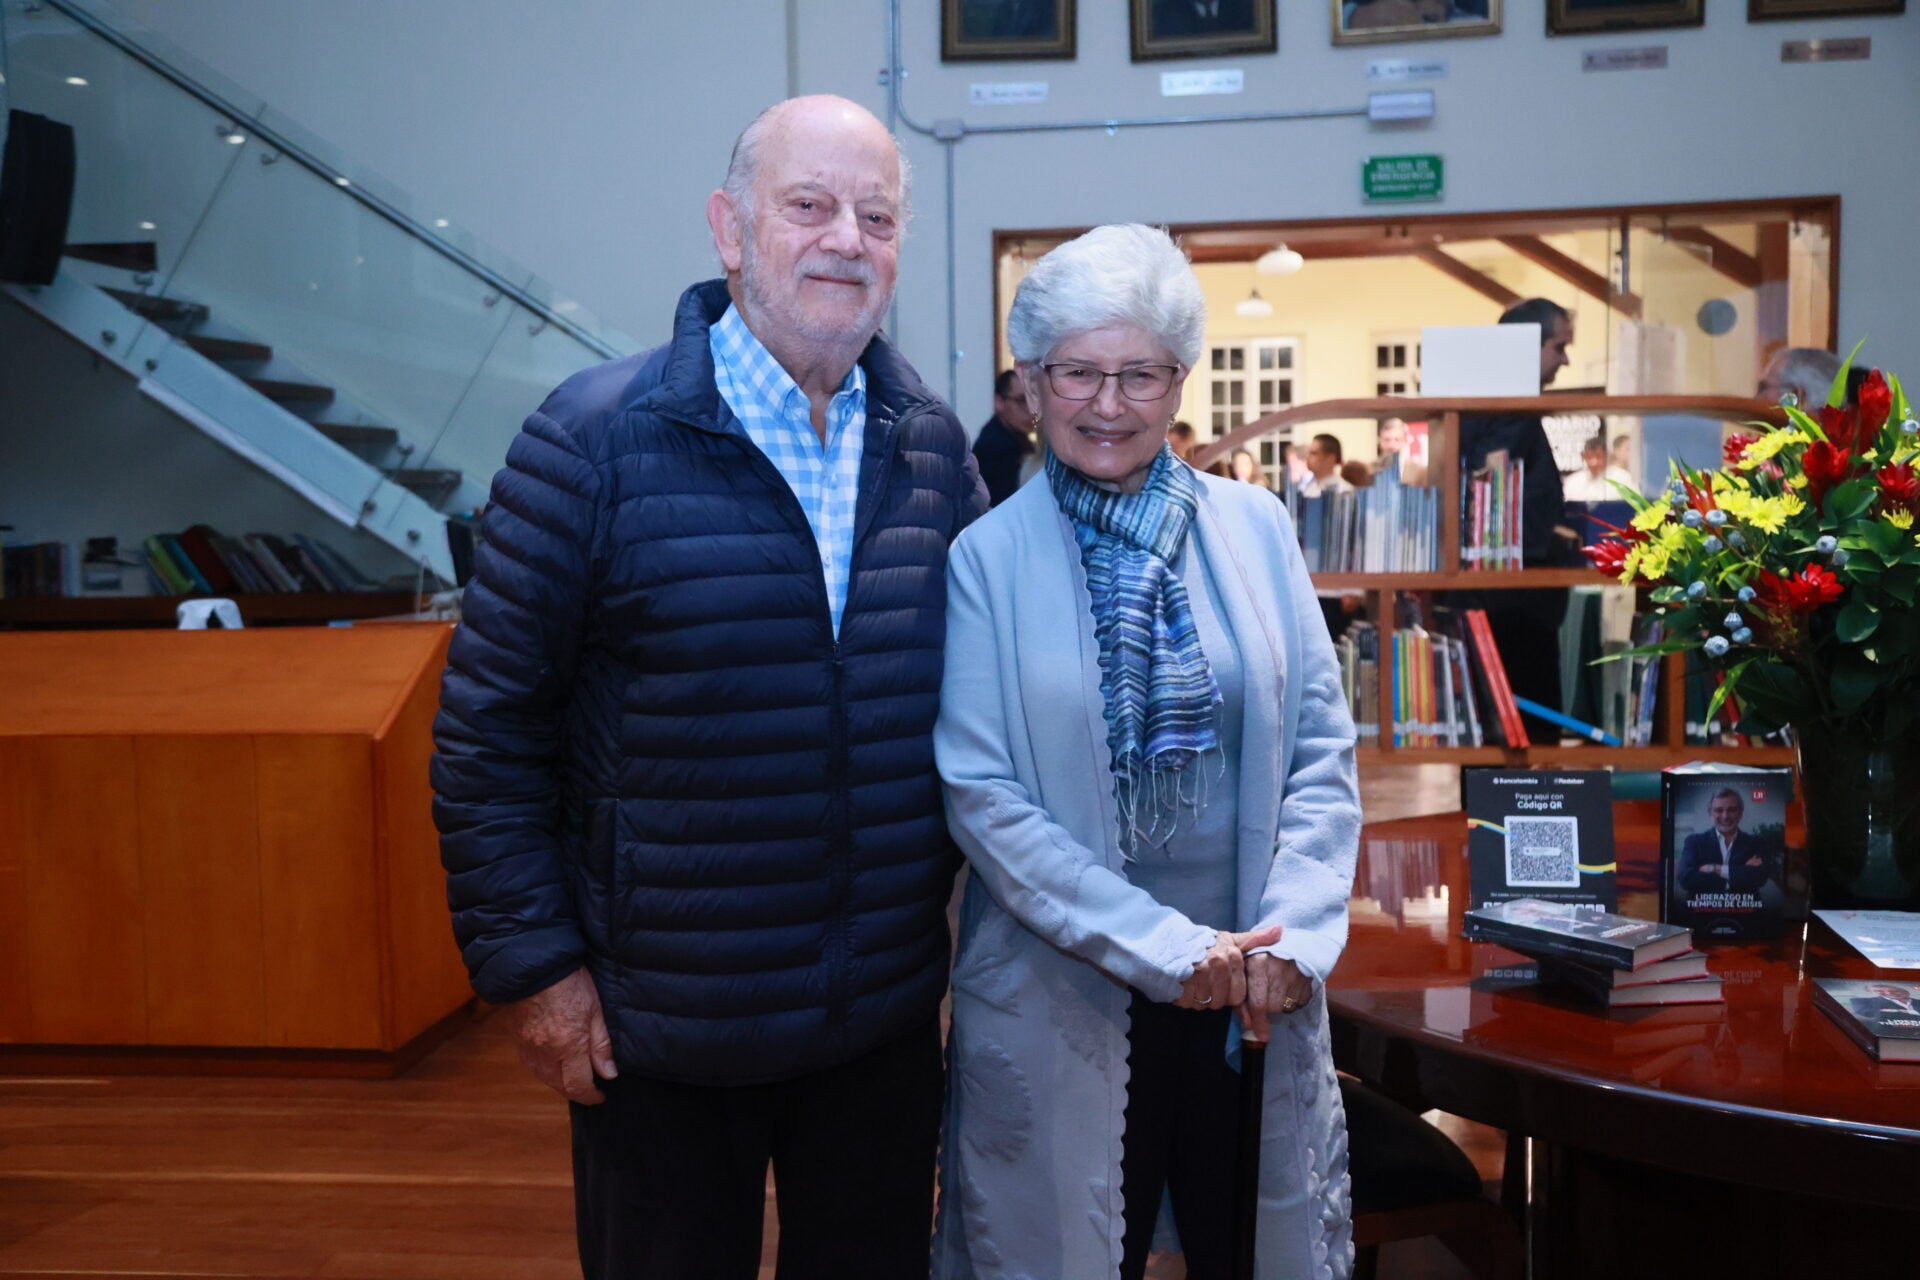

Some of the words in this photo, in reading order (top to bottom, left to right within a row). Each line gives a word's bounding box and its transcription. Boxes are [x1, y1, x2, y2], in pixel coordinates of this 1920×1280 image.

[1515, 792, 1533, 802] Paga
[1549, 801, 1563, 809] QR
[1695, 893, 1741, 901] LIDERAZGO
[1742, 893, 1754, 901] EN
[1687, 900, 1723, 908] TIEMPOS
